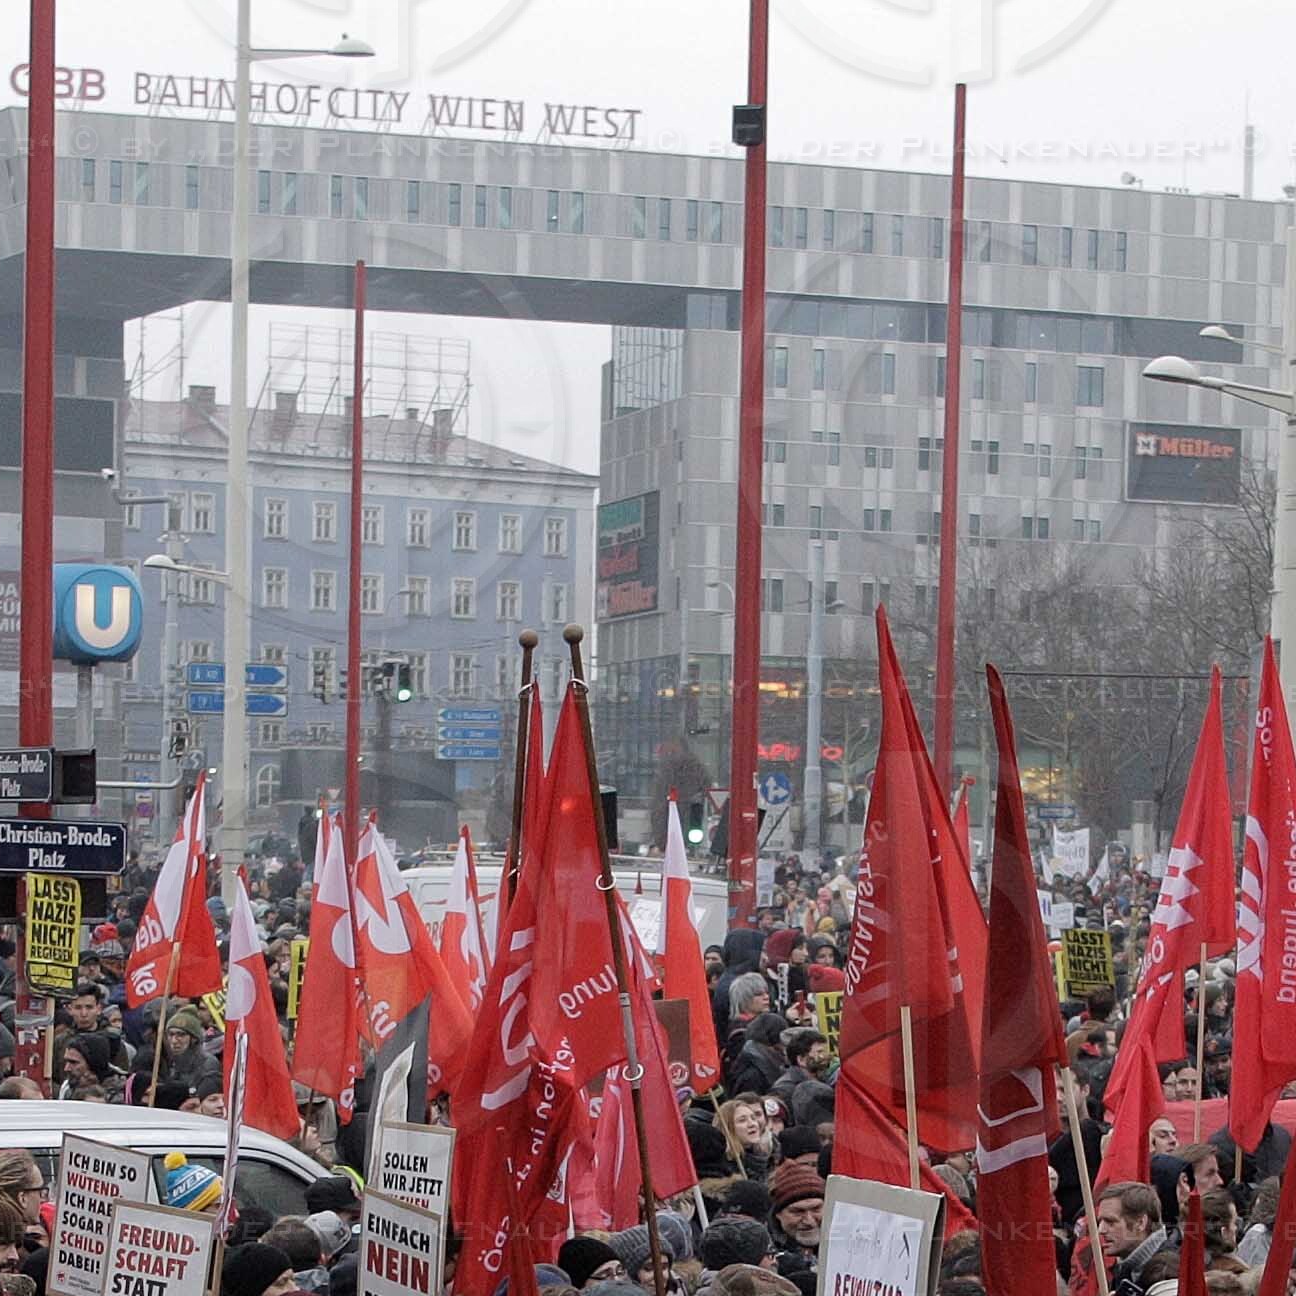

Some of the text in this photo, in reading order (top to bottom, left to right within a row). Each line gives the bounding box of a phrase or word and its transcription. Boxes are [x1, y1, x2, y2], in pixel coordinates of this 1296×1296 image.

[135, 72, 409, 122] BAHNHOFCITY
[428, 93, 524, 132] WIEN
[544, 103, 643, 140] WEST
[1158, 434, 1235, 460] Müller
[76, 584, 131, 649] U
[1, 777, 23, 798] Platz
[27, 848, 67, 868] Platz
[34, 877, 77, 903] LASST
[32, 899, 76, 925] NAZIS
[31, 922, 75, 948] NICHT
[1065, 930, 1104, 945] LASST
[1066, 944, 1106, 959] NAZIS
[1068, 959, 1107, 973] NICHT
[68, 1151, 137, 1182] ICH BIN SO
[383, 1151, 429, 1173] SOLLEN
[66, 1168, 124, 1199] WÜTEND.
[382, 1172, 443, 1197] WIR JETZT
[64, 1190, 86, 1211] ICH
[62, 1210, 104, 1236] SOGAR
[367, 1212, 431, 1254] EINFACH
[59, 1230, 105, 1257] SCHILD
[118, 1223, 201, 1256] FREUND-
[57, 1251, 101, 1278] DABEI!
[114, 1247, 188, 1280] SCHAFT
[366, 1239, 430, 1294] NEIN
